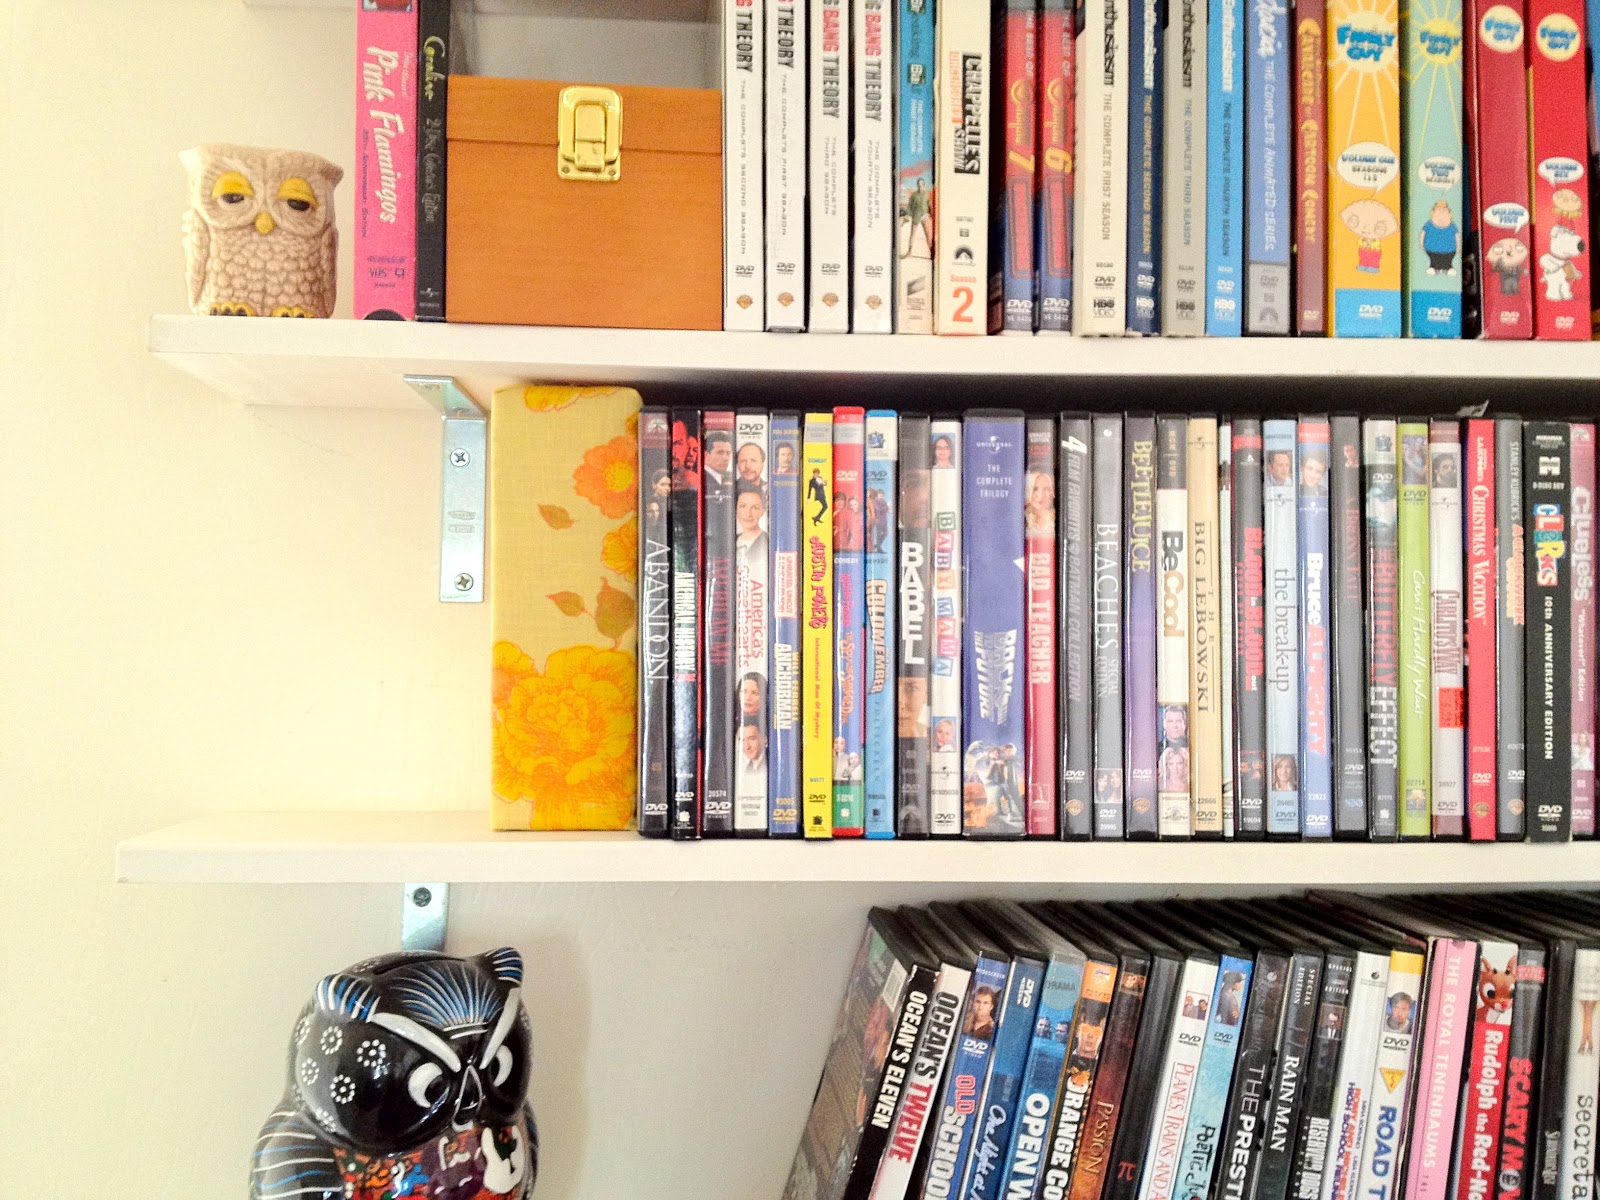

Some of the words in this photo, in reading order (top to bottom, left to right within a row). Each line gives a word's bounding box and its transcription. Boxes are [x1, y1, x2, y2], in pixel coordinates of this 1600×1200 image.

[736, 12, 753, 73] THEORY
[778, 7, 795, 69] THEORY
[823, 9, 840, 53] BANG
[865, 13, 882, 57] BANG
[1336, 25, 1397, 49] FAMILY
[1346, 44, 1384, 62] GUY
[1426, 42, 1452, 55] GUY
[1493, 29, 1517, 42] GUY
[1548, 38, 1571, 50] GUY
[362, 47, 399, 102] Pink
[423, 36, 446, 102] Coraline
[740, 80, 748, 99] THE
[780, 73, 788, 94] THE
[823, 56, 840, 119] THEORY
[865, 60, 882, 122] THEORY
[964, 57, 982, 174] CHAPPELLE'S
[1102, 94, 1112, 112] THE
[1143, 95, 1153, 113] THE
[1183, 99, 1194, 117] THE
[1222, 103, 1233, 119] THE
[1264, 83, 1276, 144] COMPLETE
[740, 103, 748, 159] COMPLETE
[780, 98, 788, 154] COMPLETE
[1101, 115, 1112, 168] COMPLETE
[1143, 116, 1153, 168] COMPLETE
[1183, 120, 1194, 172] COMPLETE
[1222, 122, 1233, 174] COMPLETE
[369, 109, 405, 223] Flamingos
[780, 157, 788, 188] FIRST
[1009, 149, 1035, 173] 7
[1044, 147, 1072, 174] 6
[1264, 146, 1276, 207] ANIMATED
[1341, 154, 1377, 164] VOLUME
[1378, 155, 1397, 165] ONE
[740, 165, 748, 207] SECOND
[1101, 169, 1112, 198] FIRST
[1143, 170, 1153, 211] SECOND
[1183, 174, 1194, 203] THIRD
[1222, 176, 1233, 215] FOURTH
[740, 211, 748, 255] SEASON
[780, 192, 788, 236] SEASON
[1101, 200, 1112, 241] SEASON
[1142, 213, 1153, 254] SEASON
[1183, 206, 1193, 246] SEASON
[1264, 209, 1276, 252] SERIES
[1222, 217, 1233, 257] SEASON
[952, 286, 974, 323] 2
[987, 463, 1001, 472] THE
[1062, 436, 1088, 454] 4
[1068, 453, 1082, 478] FILM
[1509, 441, 1521, 477] STANLEY
[976, 476, 1013, 486] COMPLETE
[979, 489, 1010, 499] TRILOGY
[1510, 478, 1522, 523] KUBRICK'S
[1131, 440, 1153, 574] BEETLEJUICE
[1471, 484, 1491, 557] CHRISTMAS
[809, 536, 828, 583] AUSTIN
[934, 510, 958, 590] BABY
[1194, 521, 1207, 565] BIG
[1533, 503, 1568, 587] CLERKS
[1571, 486, 1594, 603] Clueless
[1031, 552, 1052, 596] BAD
[1068, 555, 1081, 615] BATMAN
[1096, 523, 1119, 650] BEACHES
[1274, 568, 1297, 601] the
[1306, 552, 1324, 625] Bruce
[1472, 560, 1491, 620] VACATION
[646, 539, 671, 680] ABANDON
[674, 572, 696, 623] AMERICAN
[750, 579, 766, 660] America's
[808, 585, 829, 630] POWERS
[902, 542, 926, 665] BABEL
[1544, 595, 1555, 620] 10th
[932, 596, 960, 678] MAMA
[1031, 600, 1052, 685] TEACHER
[1194, 576, 1209, 714] LEBOWSKI
[1370, 562, 1398, 687] BUTTERFLY
[1406, 617, 1427, 675] Hardly
[674, 626, 696, 671] HISTORY
[792, 651, 800, 676] WILL
[812, 637, 822, 681] International
[1067, 619, 1081, 702] COLLECTION
[1268, 604, 1298, 693] break-up
[1544, 623, 1555, 707] ANNIVERSARY
[776, 643, 792, 730] ANCHORMAN
[812, 684, 822, 701] Man
[1097, 655, 1108, 698] EDITION
[1108, 658, 1120, 694] SPECIAL
[1250, 675, 1258, 692] out
[1307, 624, 1326, 757] ALMIGHTY
[792, 680, 800, 723] FERRELL
[1413, 680, 1427, 720] Wait
[811, 712, 822, 740] Mystery
[1370, 686, 1398, 769] EFFECT
[1544, 710, 1555, 760] EDITION
[1293, 966, 1306, 1005] EDITION
[1303, 968, 1316, 1007] SPECIAL
[1445, 955, 1462, 987] THE
[892, 991, 927, 1065] OCEAN'S
[914, 991, 960, 1080] OCEAN'S
[1180, 1032, 1202, 1046] DVD
[1438, 992, 1458, 1047] ROYAL
[963, 1039, 989, 1054] DVD
[1383, 1037, 1410, 1052] DVD
[1241, 1064, 1267, 1114] THE
[1280, 1054, 1301, 1102] RAIN
[1475, 1029, 1504, 1111] Rudolph
[871, 1064, 907, 1129] ELEVEN
[955, 1074, 977, 1116] OLD
[1345, 1082, 1356, 1111] HIGH
[1422, 1054, 1451, 1168] TENENBAUMS
[1503, 1056, 1534, 1146] SCARY
[888, 1081, 934, 1164] TWELVE
[1013, 1092, 1050, 1176] OPEN
[1050, 1069, 1090, 1169] ORANGE
[1084, 1100, 1115, 1174] PASSION
[1159, 1115, 1185, 1159] TRAINS
[1269, 1105, 1292, 1152] MAN
[1337, 1113, 1352, 1161] SCHOOL
[1345, 1124, 1357, 1149] AND
[1371, 1105, 1398, 1178] ROAD
[1475, 1112, 1489, 1132] the
[1303, 1117, 1331, 1171] RESERVOIR
[1152, 1159, 1171, 1191] AND
